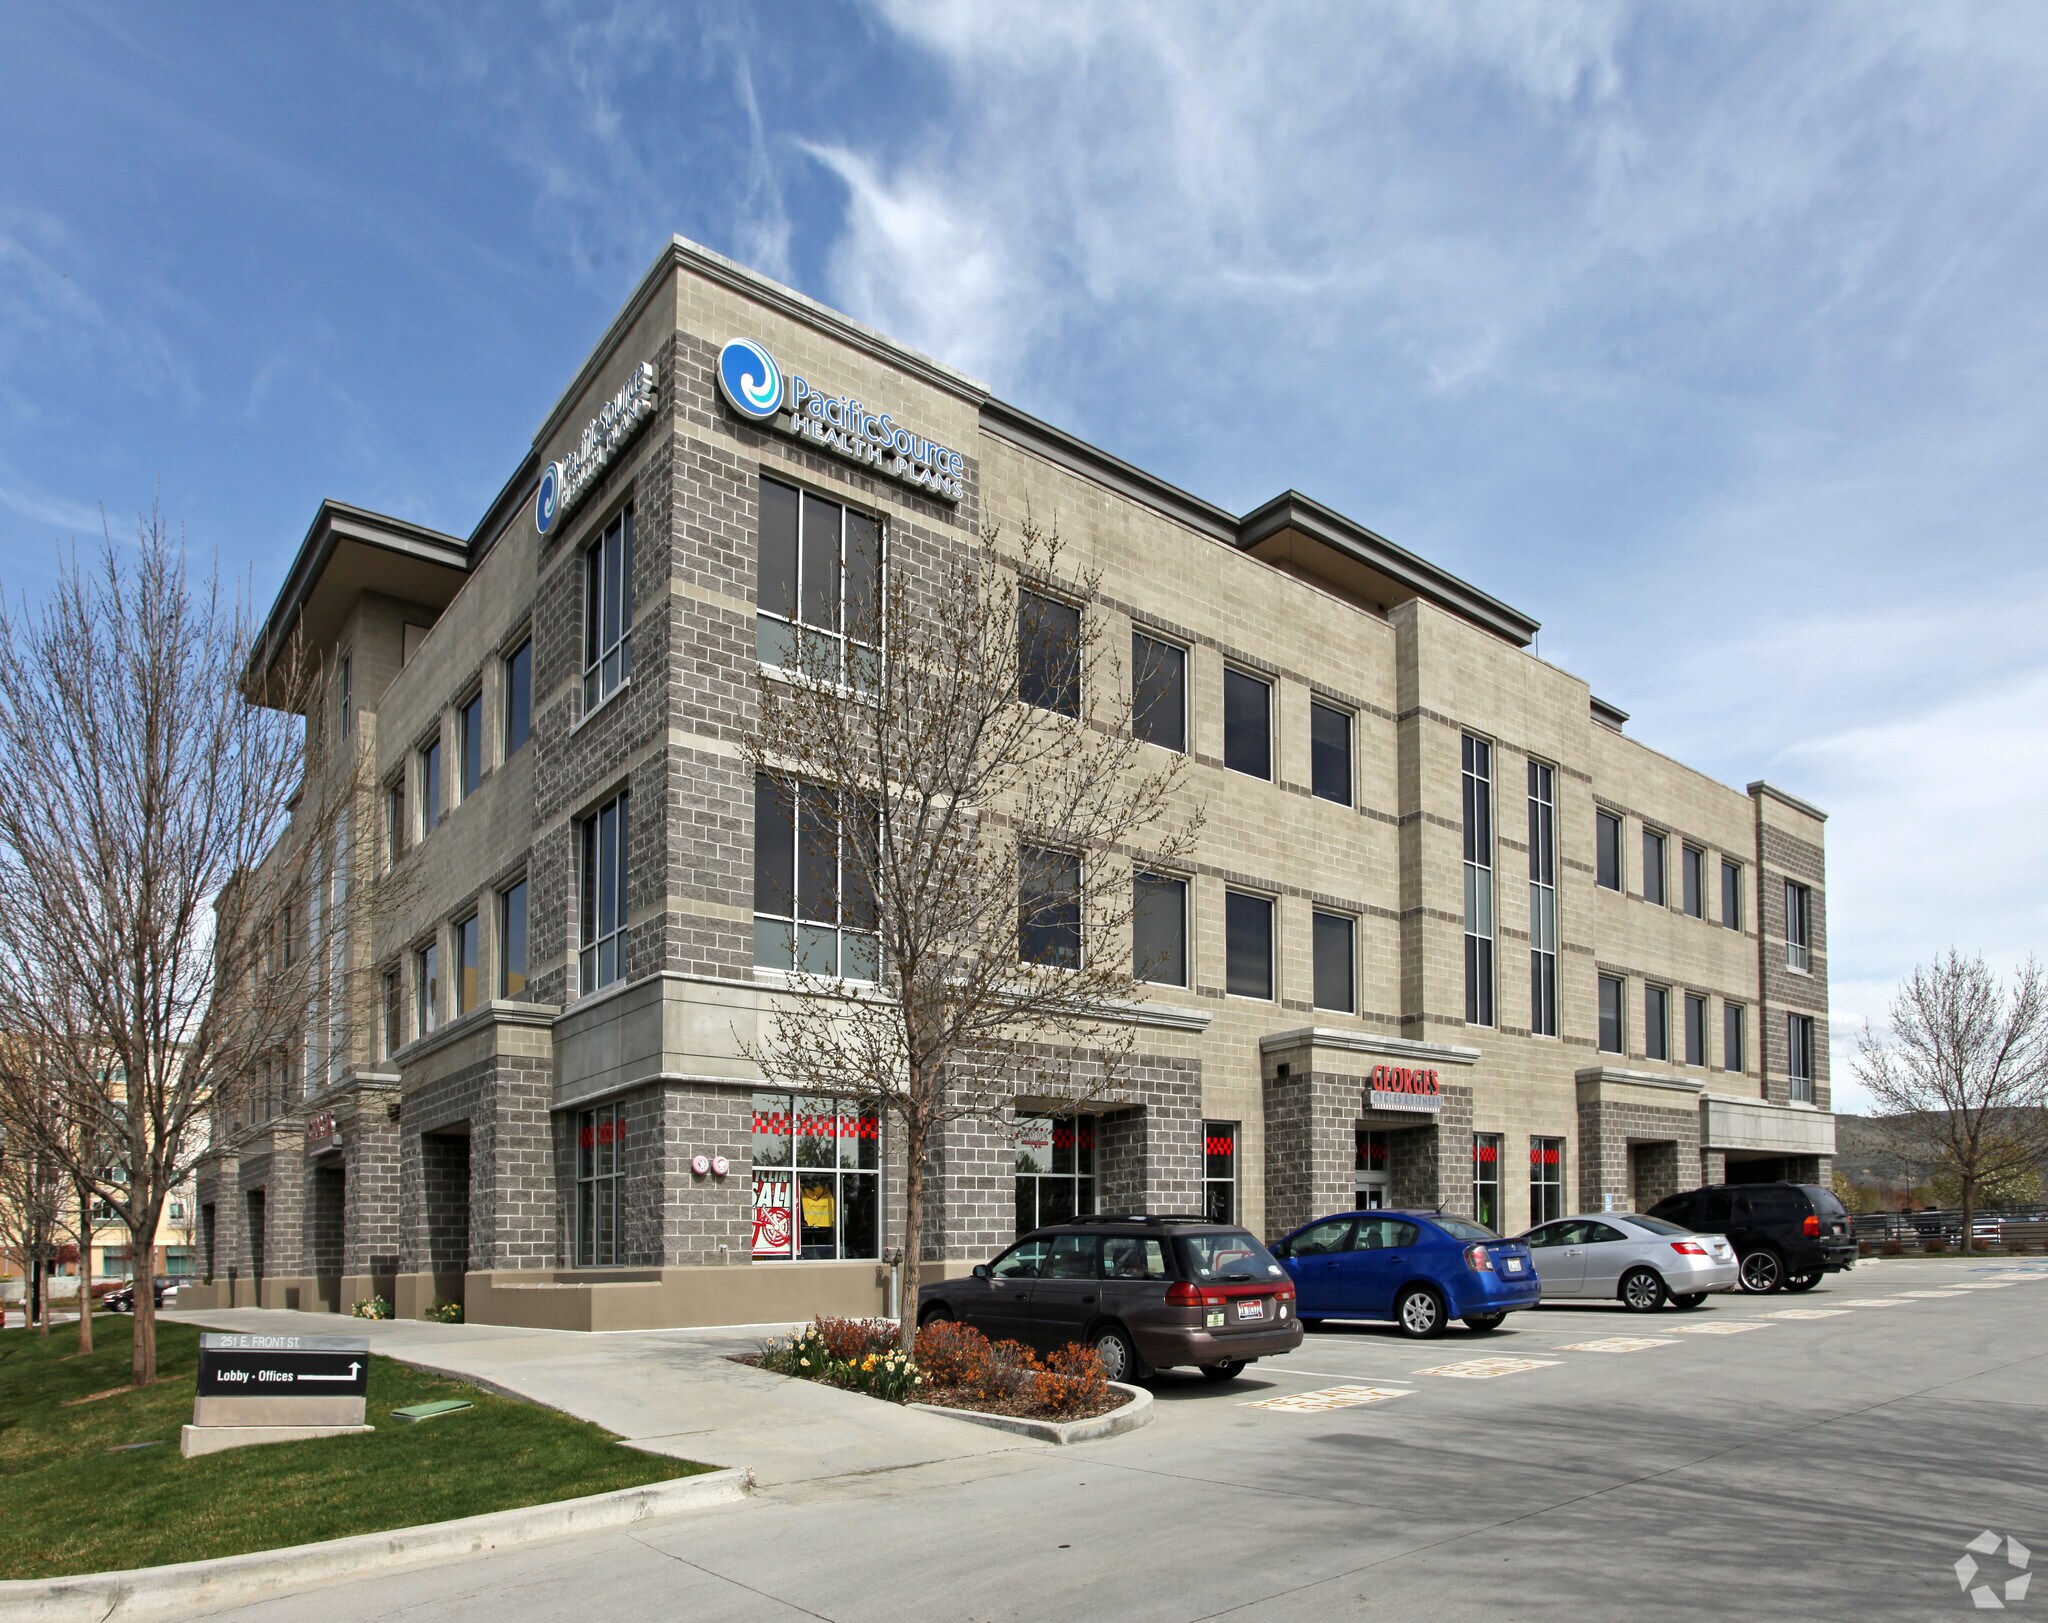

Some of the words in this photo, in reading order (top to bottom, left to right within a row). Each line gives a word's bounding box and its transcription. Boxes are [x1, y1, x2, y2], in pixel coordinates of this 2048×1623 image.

[792, 373, 964, 478] PacificSource
[793, 412, 882, 465] HEALTH
[896, 456, 964, 499] PLANS
[1373, 1092, 1402, 1104] CYCLES
[1411, 1095, 1440, 1107] FITNESS
[221, 1336, 238, 1347] 251
[240, 1336, 250, 1347] E.
[252, 1336, 285, 1348] FRONT
[287, 1336, 300, 1348] ST.
[217, 1369, 250, 1383] Lobby
[258, 1370, 294, 1382] Offices
